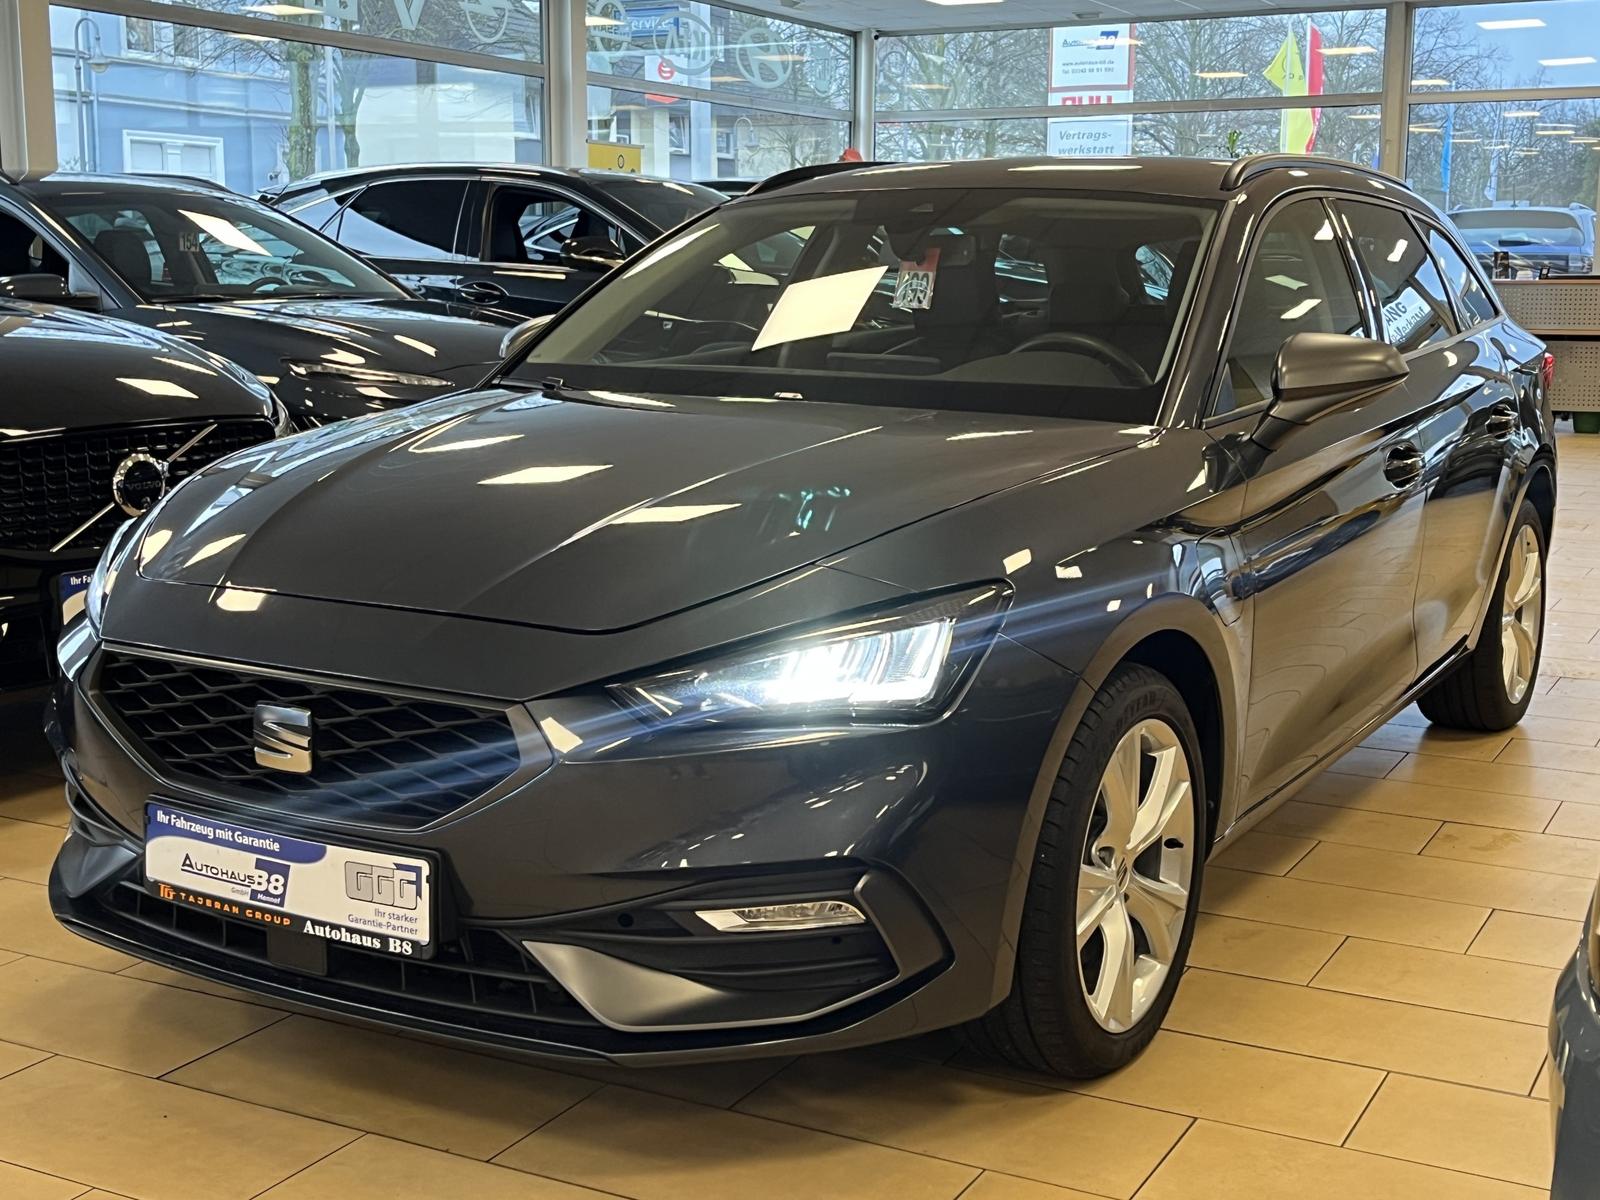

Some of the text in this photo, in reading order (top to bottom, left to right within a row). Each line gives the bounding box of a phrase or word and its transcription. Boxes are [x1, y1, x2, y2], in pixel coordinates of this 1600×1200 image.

[1060, 131, 1112, 141] Vertrags-
[1058, 145, 1114, 155] werkstatt
[126, 480, 162, 490] VOLVO
[70, 576, 81, 585] Ihr
[156, 810, 280, 852] Ihr Fahrzeug mit Garantie
[251, 868, 285, 895] B8
[344, 861, 417, 911] GGG
[245, 909, 291, 925] GROUP
[348, 913, 418, 935] Garantie-Partner
[374, 908, 418, 924] Ihr starker
[303, 920, 413, 955] Autohaus B8
